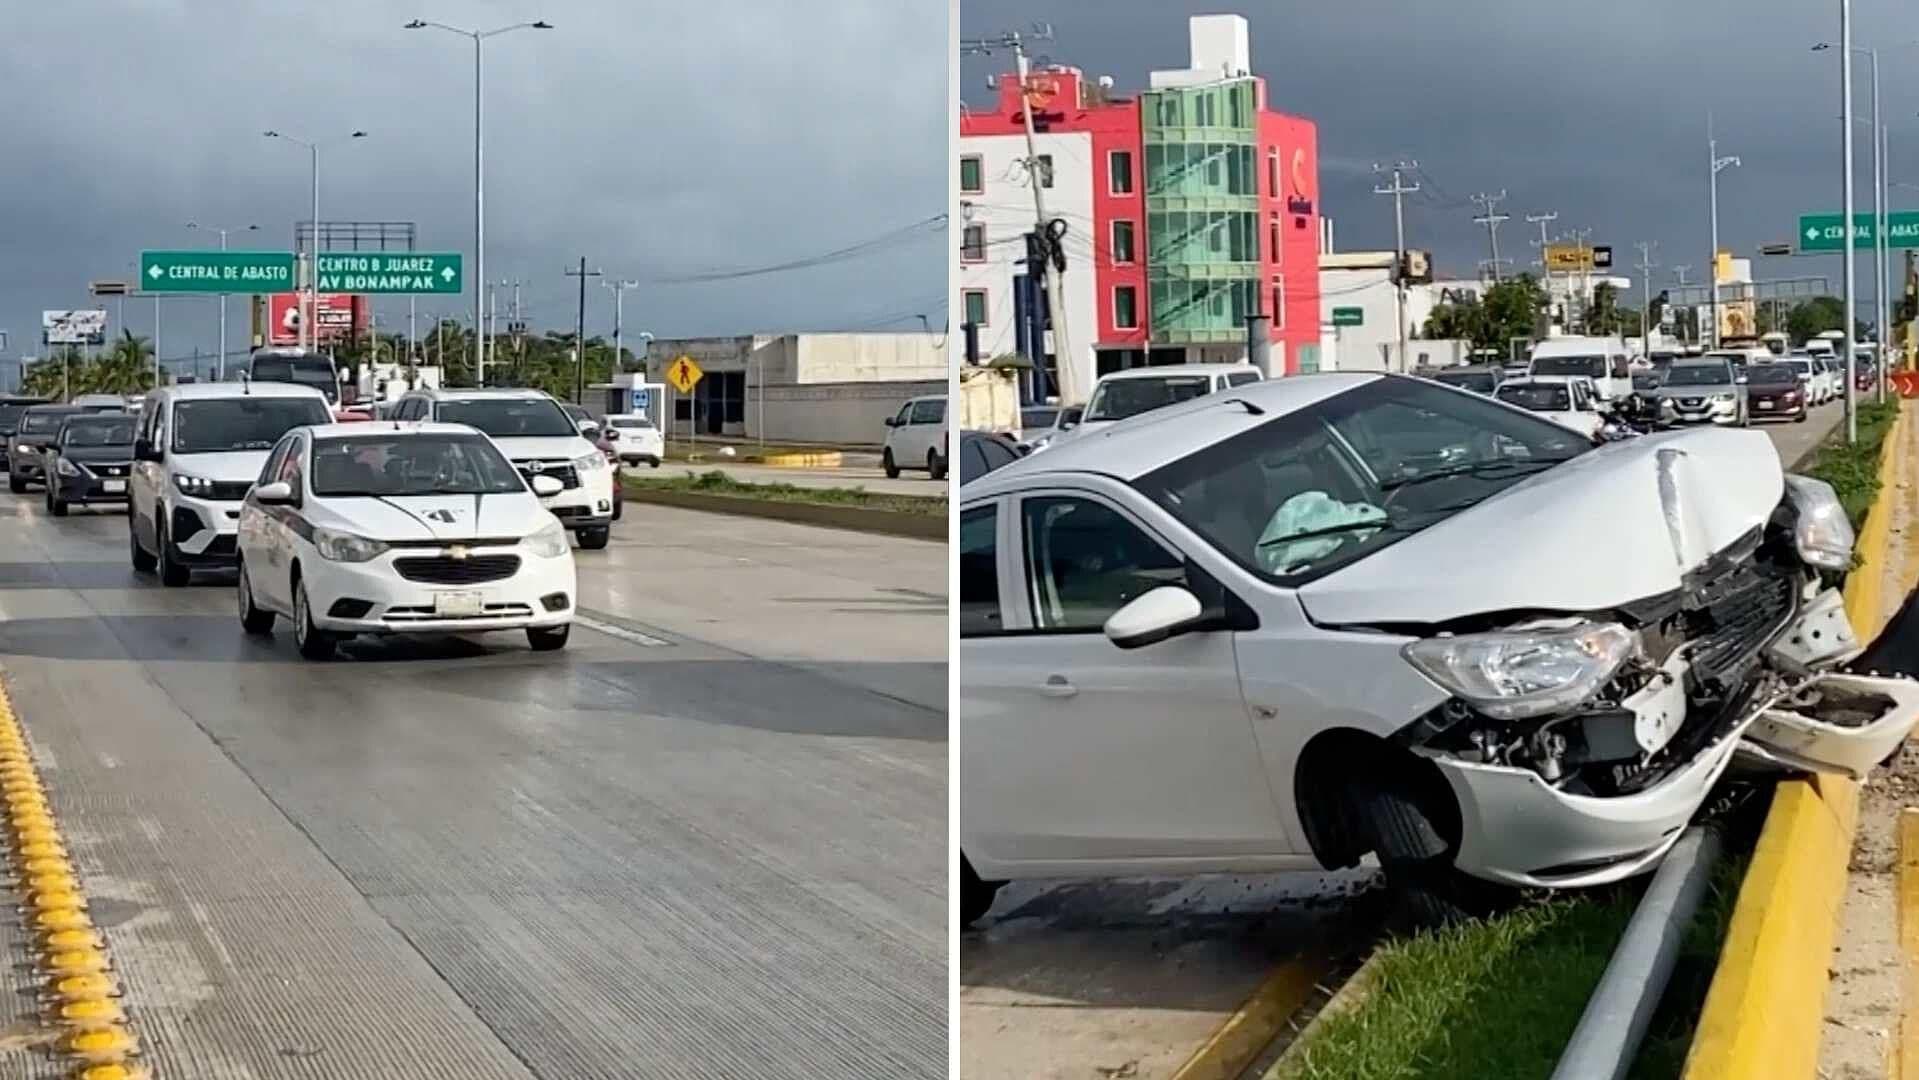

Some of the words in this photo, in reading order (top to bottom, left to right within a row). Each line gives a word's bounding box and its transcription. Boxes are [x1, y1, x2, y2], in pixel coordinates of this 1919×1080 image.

[1823, 225, 1871, 239] CENRAL
[318, 257, 368, 272] CENTRO
[371, 258, 380, 272] B
[385, 257, 434, 272] JUAREZ
[168, 265, 220, 279] CENTRAL
[223, 265, 239, 279] DE
[241, 265, 288, 279] ABASTO
[319, 275, 340, 289] AV
[344, 275, 434, 289] BONAMPAK
